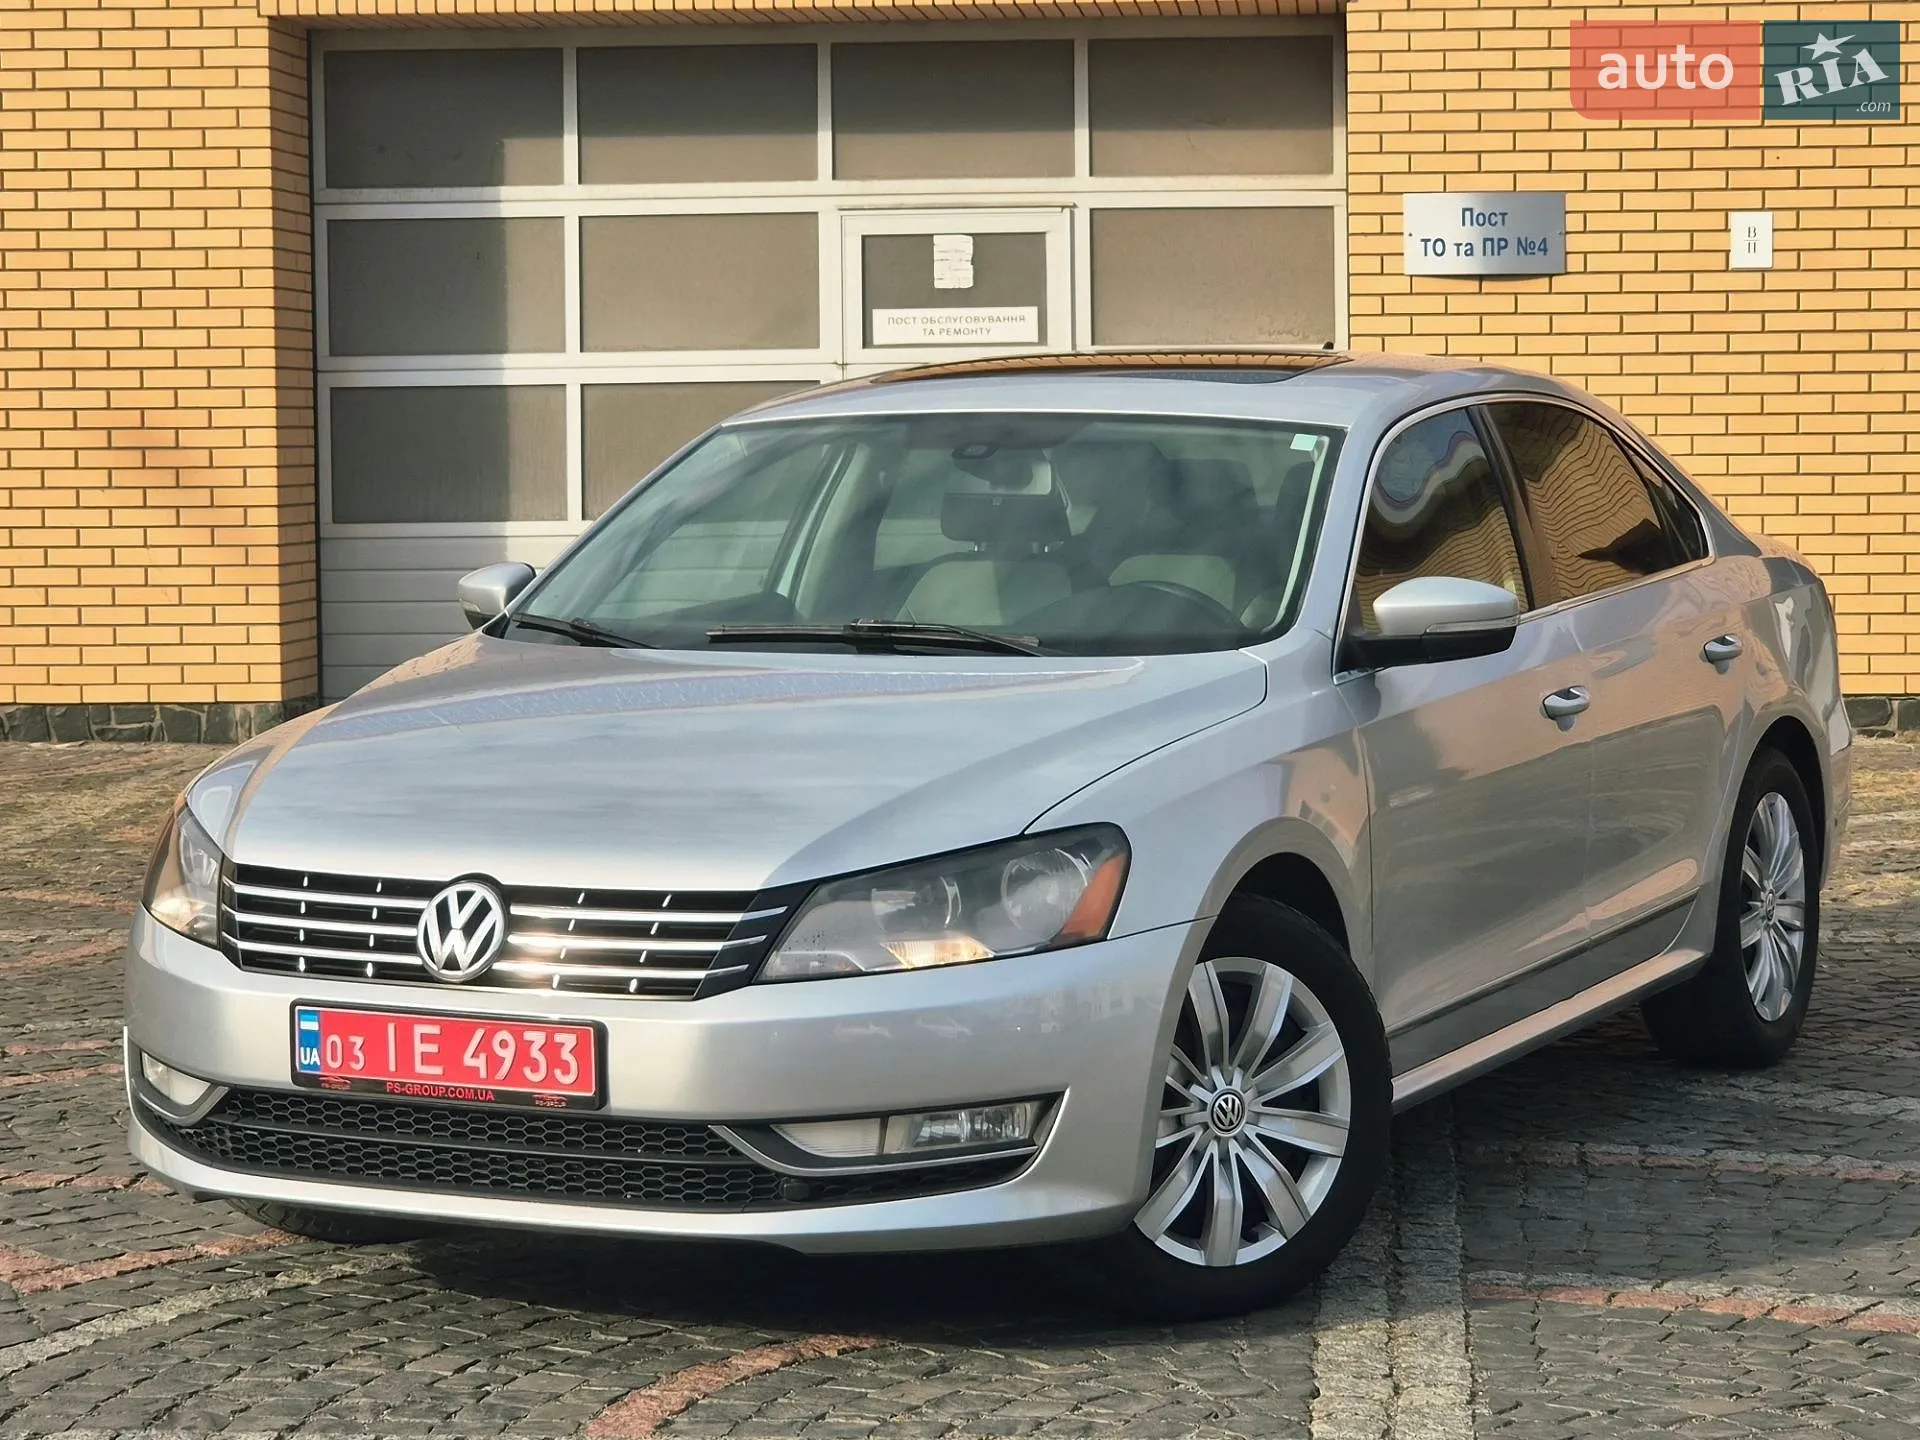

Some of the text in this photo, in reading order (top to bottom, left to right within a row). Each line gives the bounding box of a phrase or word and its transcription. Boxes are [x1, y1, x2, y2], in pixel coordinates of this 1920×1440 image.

[1460, 207, 1509, 228] Пост
[1420, 236, 1549, 258] ТО та ПР №4
[887, 315, 1026, 325] ПОСТ ОБСЛУГОВУВАННЯ
[922, 327, 992, 336] ТА РЕМОНТУ
[299, 1047, 321, 1066] UA
[325, 1034, 367, 1072] 03
[462, 1027, 580, 1086] 4933
[385, 1080, 495, 1101] PS-GROUP.COM.UA
